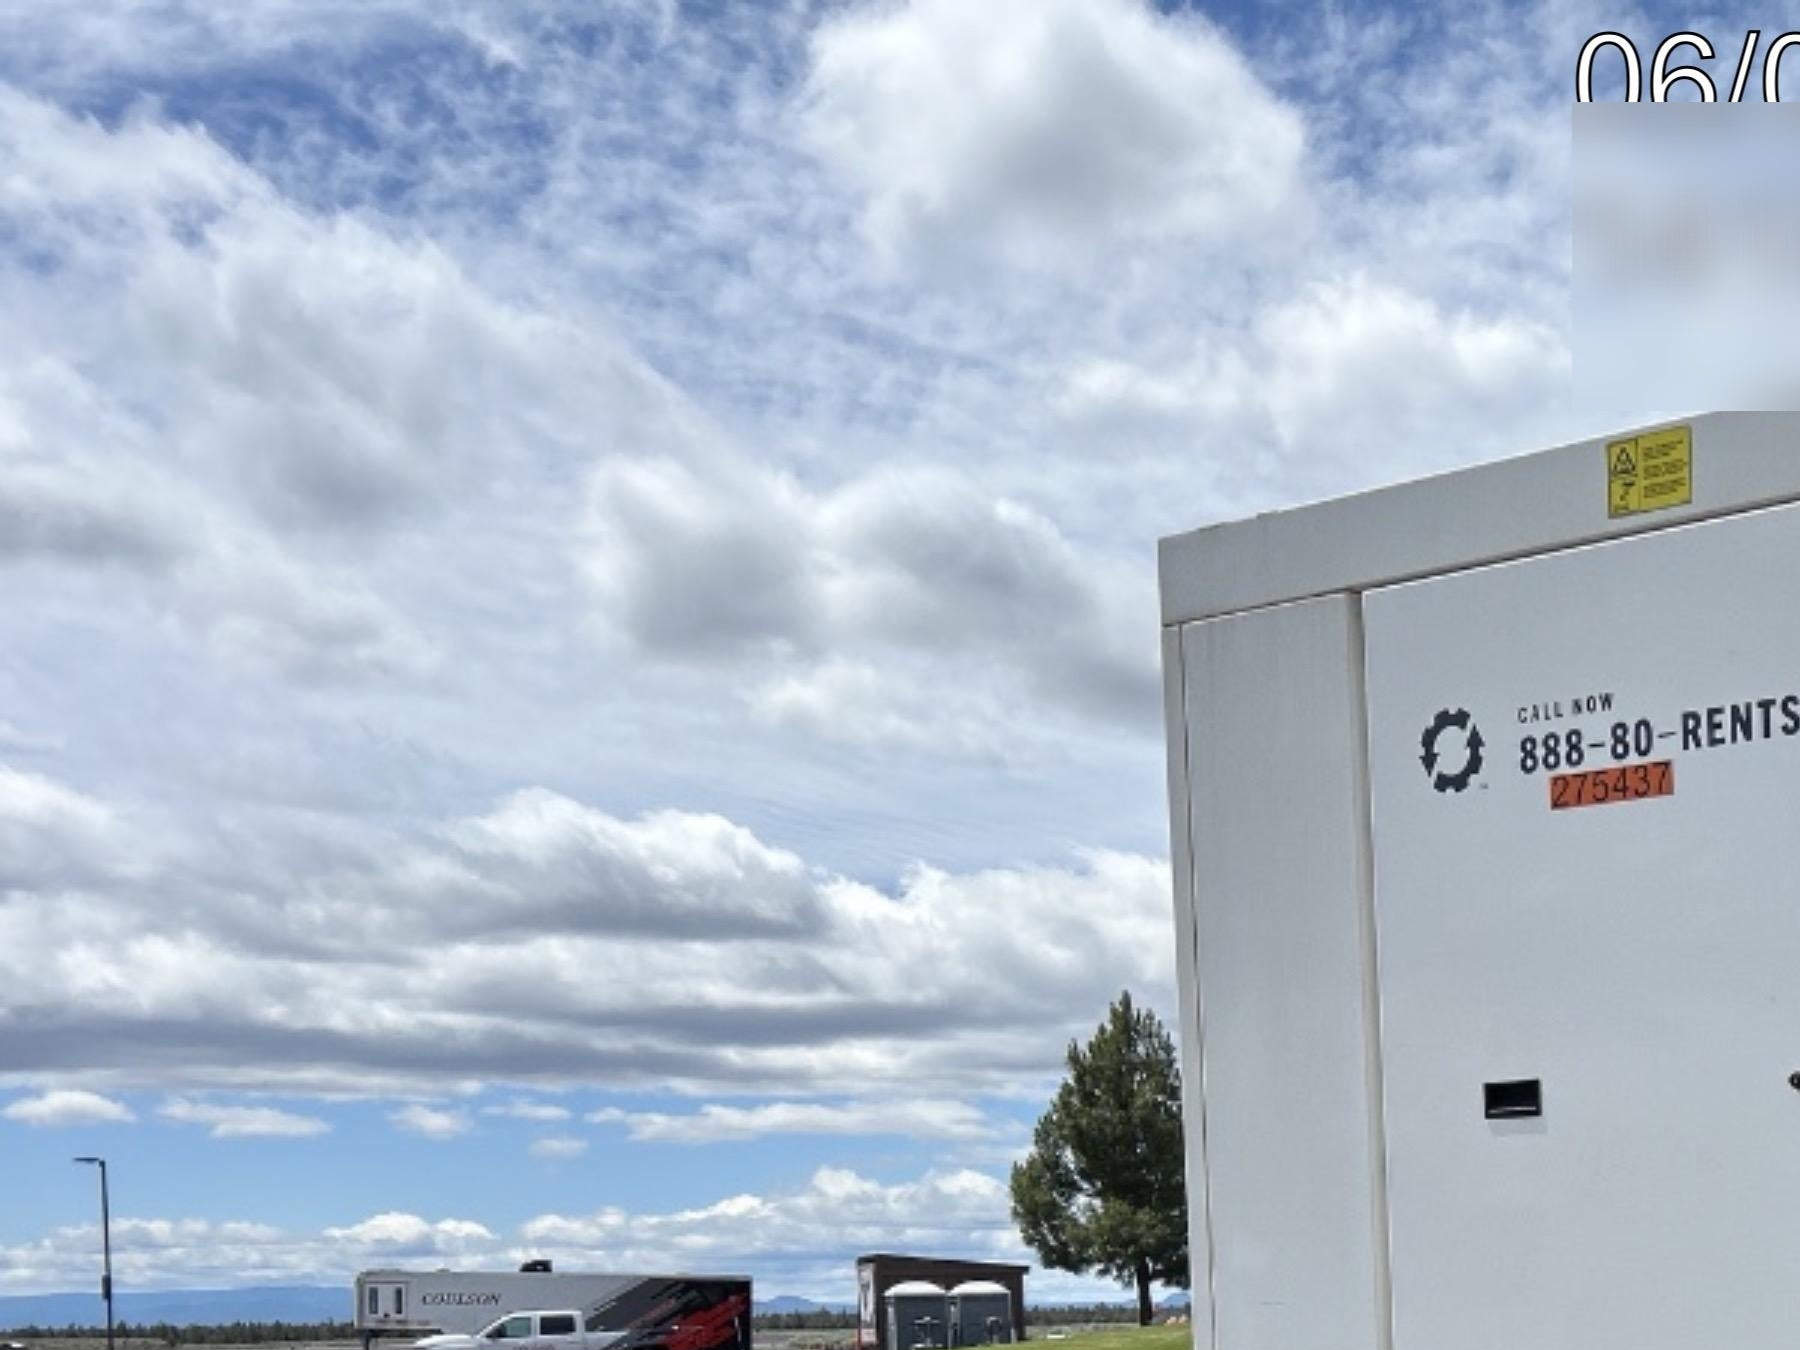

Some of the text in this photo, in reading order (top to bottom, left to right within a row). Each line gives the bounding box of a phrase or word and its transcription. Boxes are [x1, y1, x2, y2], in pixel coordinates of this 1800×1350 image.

[1518, 692, 1614, 723] CALL NOW
[1551, 761, 1672, 809] 275437
